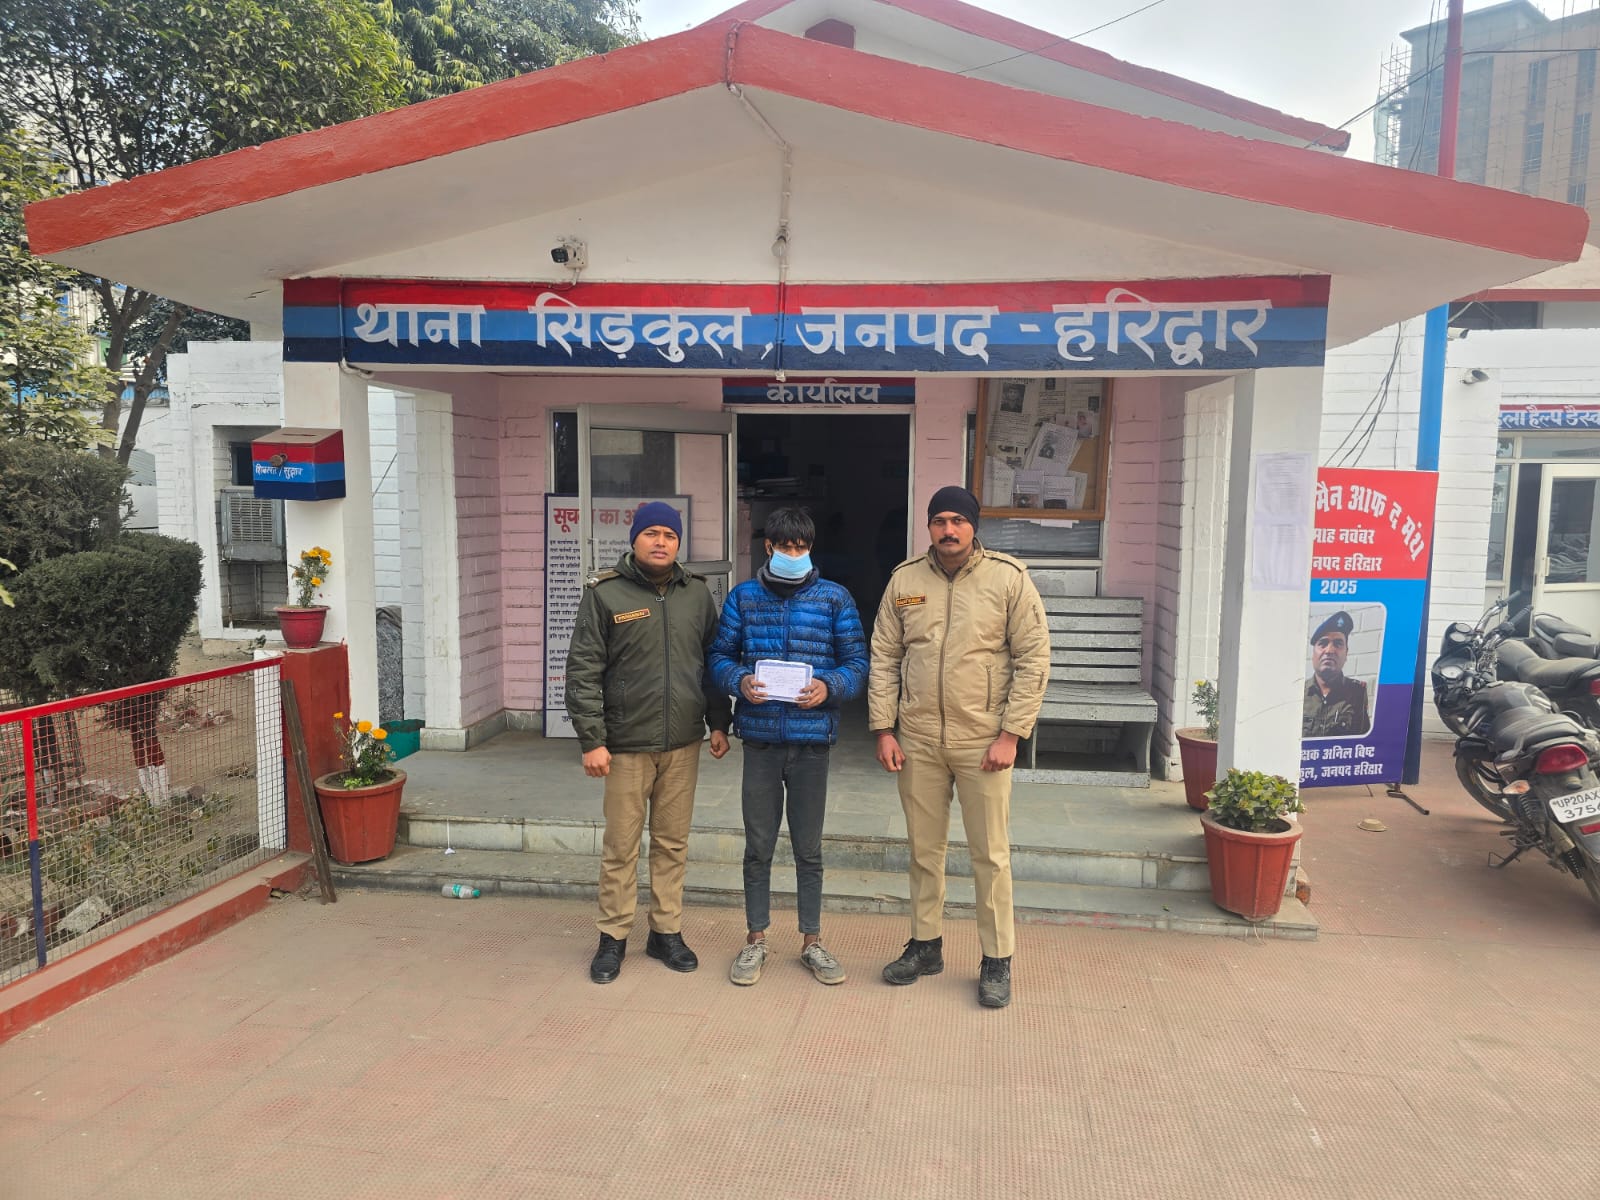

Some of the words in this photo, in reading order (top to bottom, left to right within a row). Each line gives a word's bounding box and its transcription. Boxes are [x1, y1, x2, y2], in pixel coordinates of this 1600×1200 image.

[354, 303, 488, 349] थाना
[796, 306, 1000, 364] जनपद
[1389, 501, 1402, 530] द
[1320, 580, 1358, 594] 2025
[1322, 745, 1353, 760] अनिल
[1321, 765, 1352, 777] जनपद
